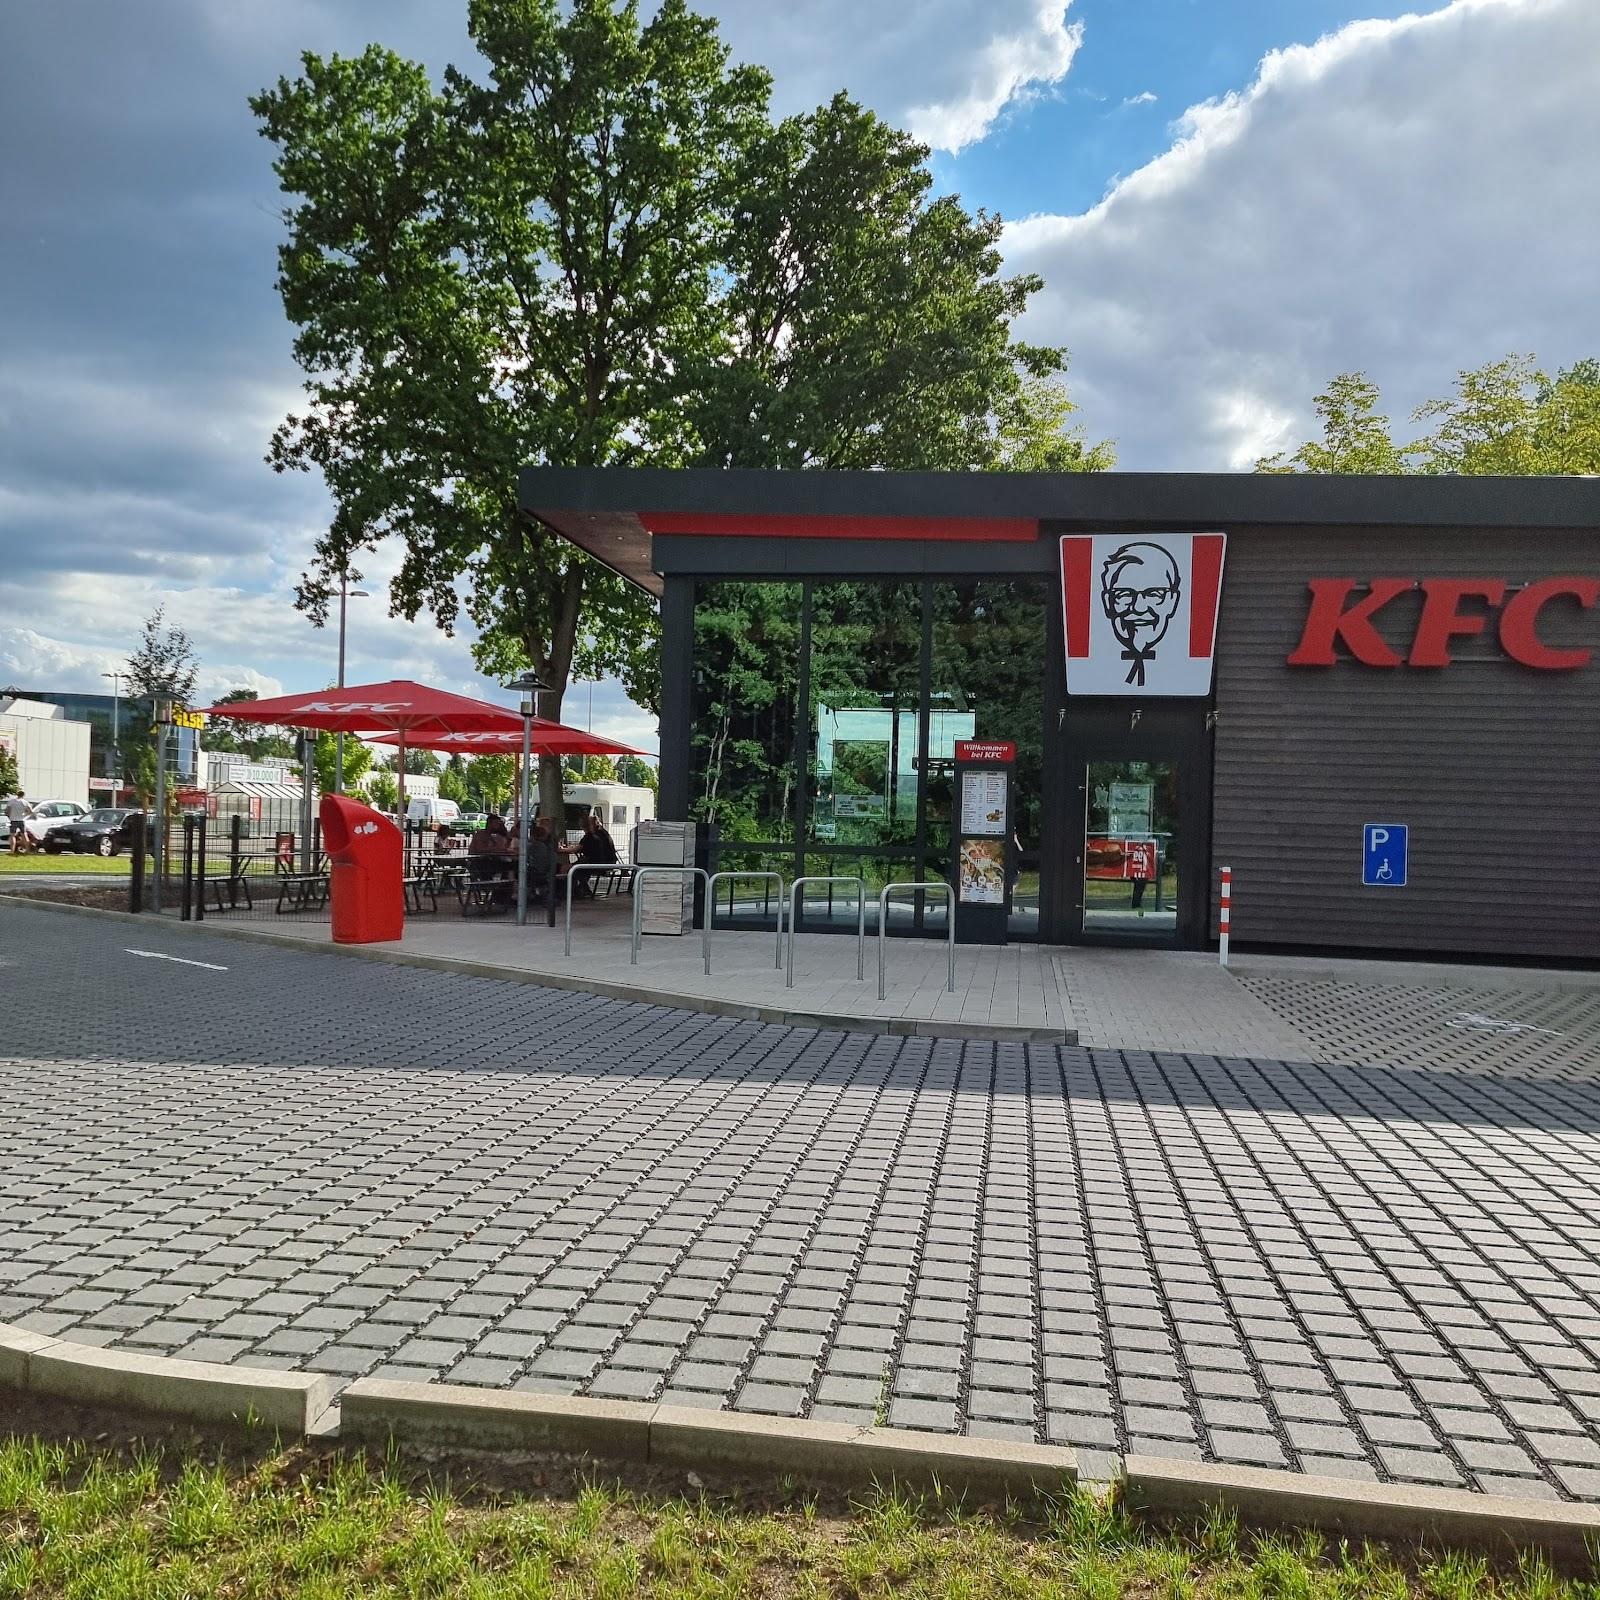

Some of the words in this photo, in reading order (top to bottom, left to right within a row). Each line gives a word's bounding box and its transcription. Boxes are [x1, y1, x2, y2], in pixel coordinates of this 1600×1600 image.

[1286, 576, 1600, 668] KFC
[292, 702, 412, 712] KFC
[436, 732, 525, 741] KFC
[963, 744, 1008, 752] Willkommen
[1371, 828, 1390, 852] P
